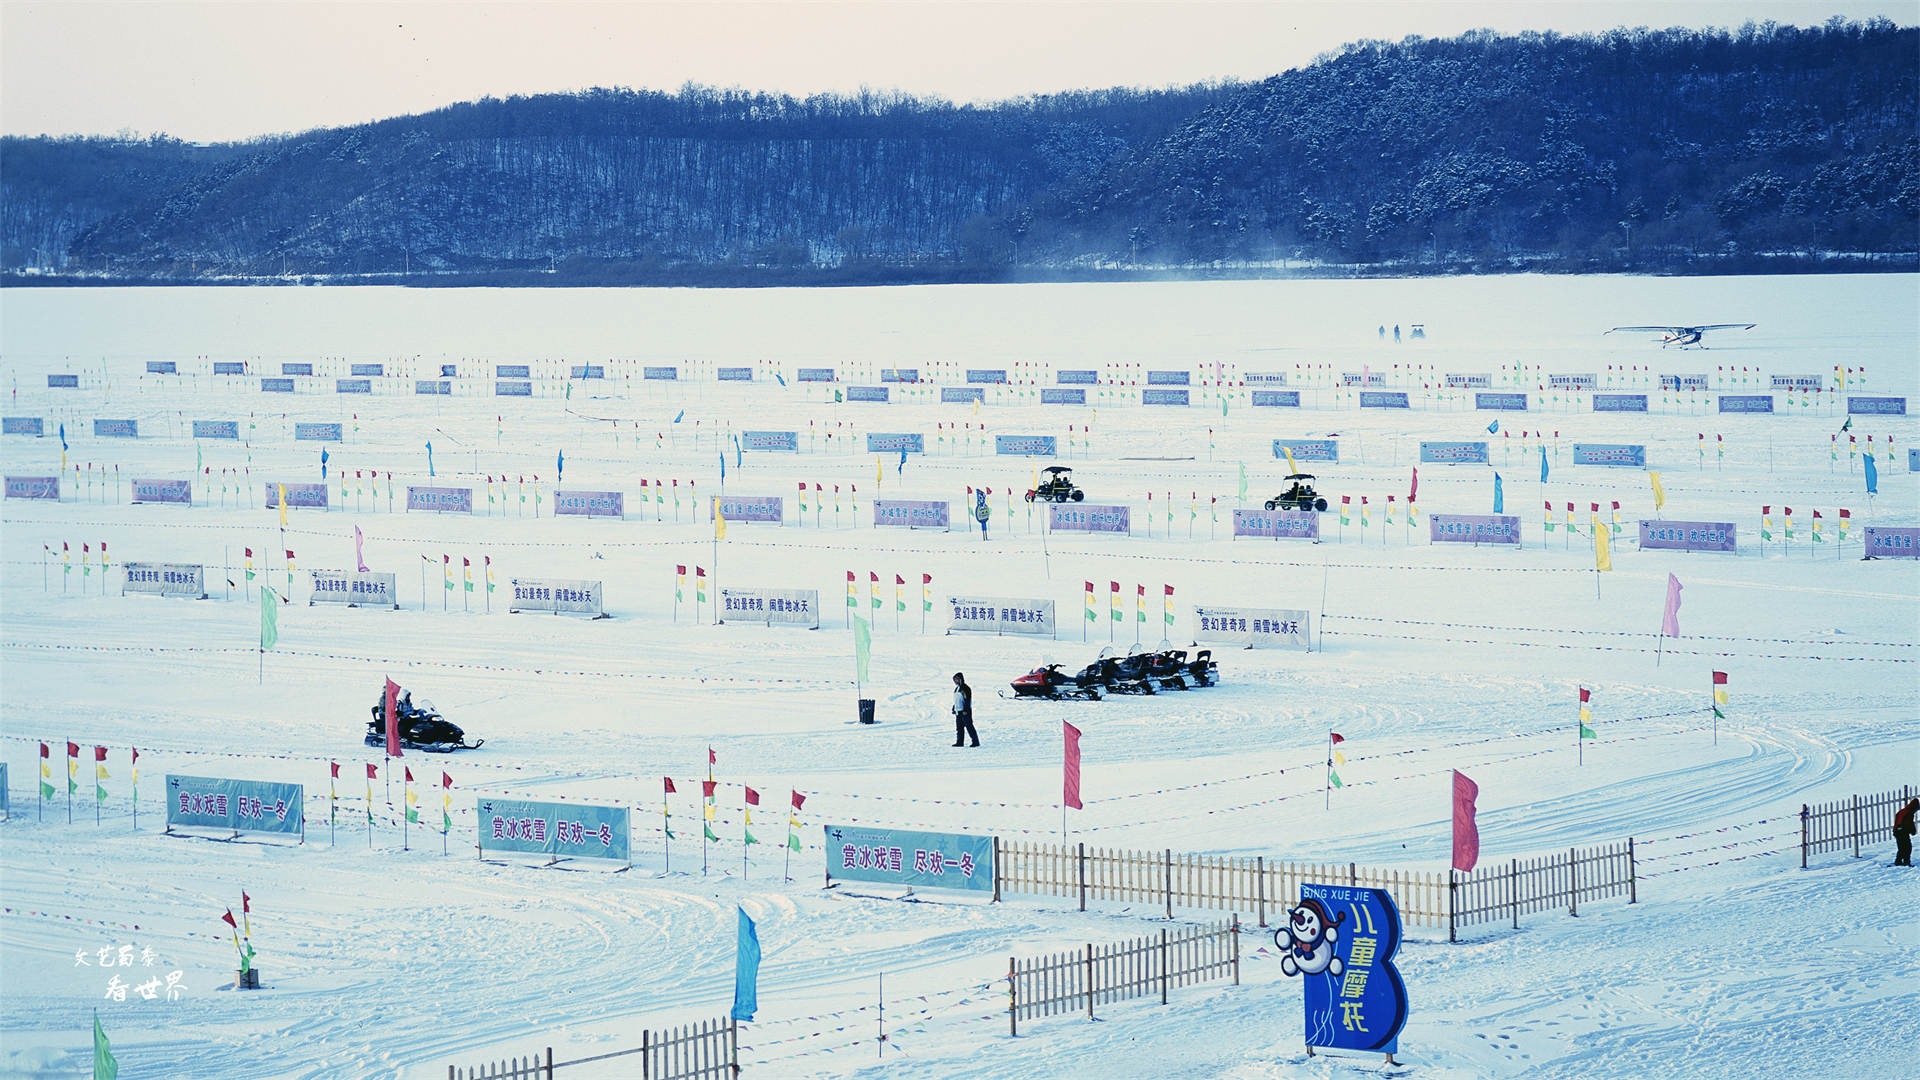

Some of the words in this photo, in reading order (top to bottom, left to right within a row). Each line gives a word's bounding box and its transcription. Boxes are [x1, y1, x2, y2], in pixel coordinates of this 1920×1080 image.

[1240, 517, 1272, 530] 冰城雪堡
[1276, 518, 1308, 532] 欢乐世界
[1438, 522, 1472, 535] 冰城雪堡
[1476, 524, 1512, 537] 欢乐世界
[1648, 528, 1686, 542] 冰城雪堡
[1690, 529, 1726, 544] 欢乐世界
[1874, 534, 1913, 548] 冰城雪堡
[128, 570, 160, 582] 赏幻景奇观
[163, 571, 196, 584] 闹雪地冰天
[314, 580, 348, 592] 赏幻景奇观
[352, 580, 386, 594] 闹雪地冰天
[514, 586, 550, 600] 赏幻景奇观
[555, 588, 592, 602] 闹雪地冰天
[725, 596, 763, 611] 赏幻景奇观
[769, 598, 808, 612] 闹雪地冰天
[954, 606, 996, 620] 赏幻景奇观
[1001, 608, 1044, 622] 闹雪地冰天
[1201, 616, 1247, 632] 赏幻景奇观
[1253, 618, 1298, 634] 闹雪地冰天
[178, 791, 228, 818] 赏冰戏雪
[237, 796, 288, 822] 尽欢一冬
[492, 816, 546, 842] 赏冰戏雪
[556, 820, 613, 848] 尽欢一冬
[842, 844, 904, 873] 赏冰戏雪
[914, 848, 976, 878] 尽欢一冬
[1303, 887, 1328, 900] BING
[1330, 889, 1351, 900] XUE
[1353, 890, 1370, 902] JIE
[1340, 902, 1378, 1033] 儿童摩托
